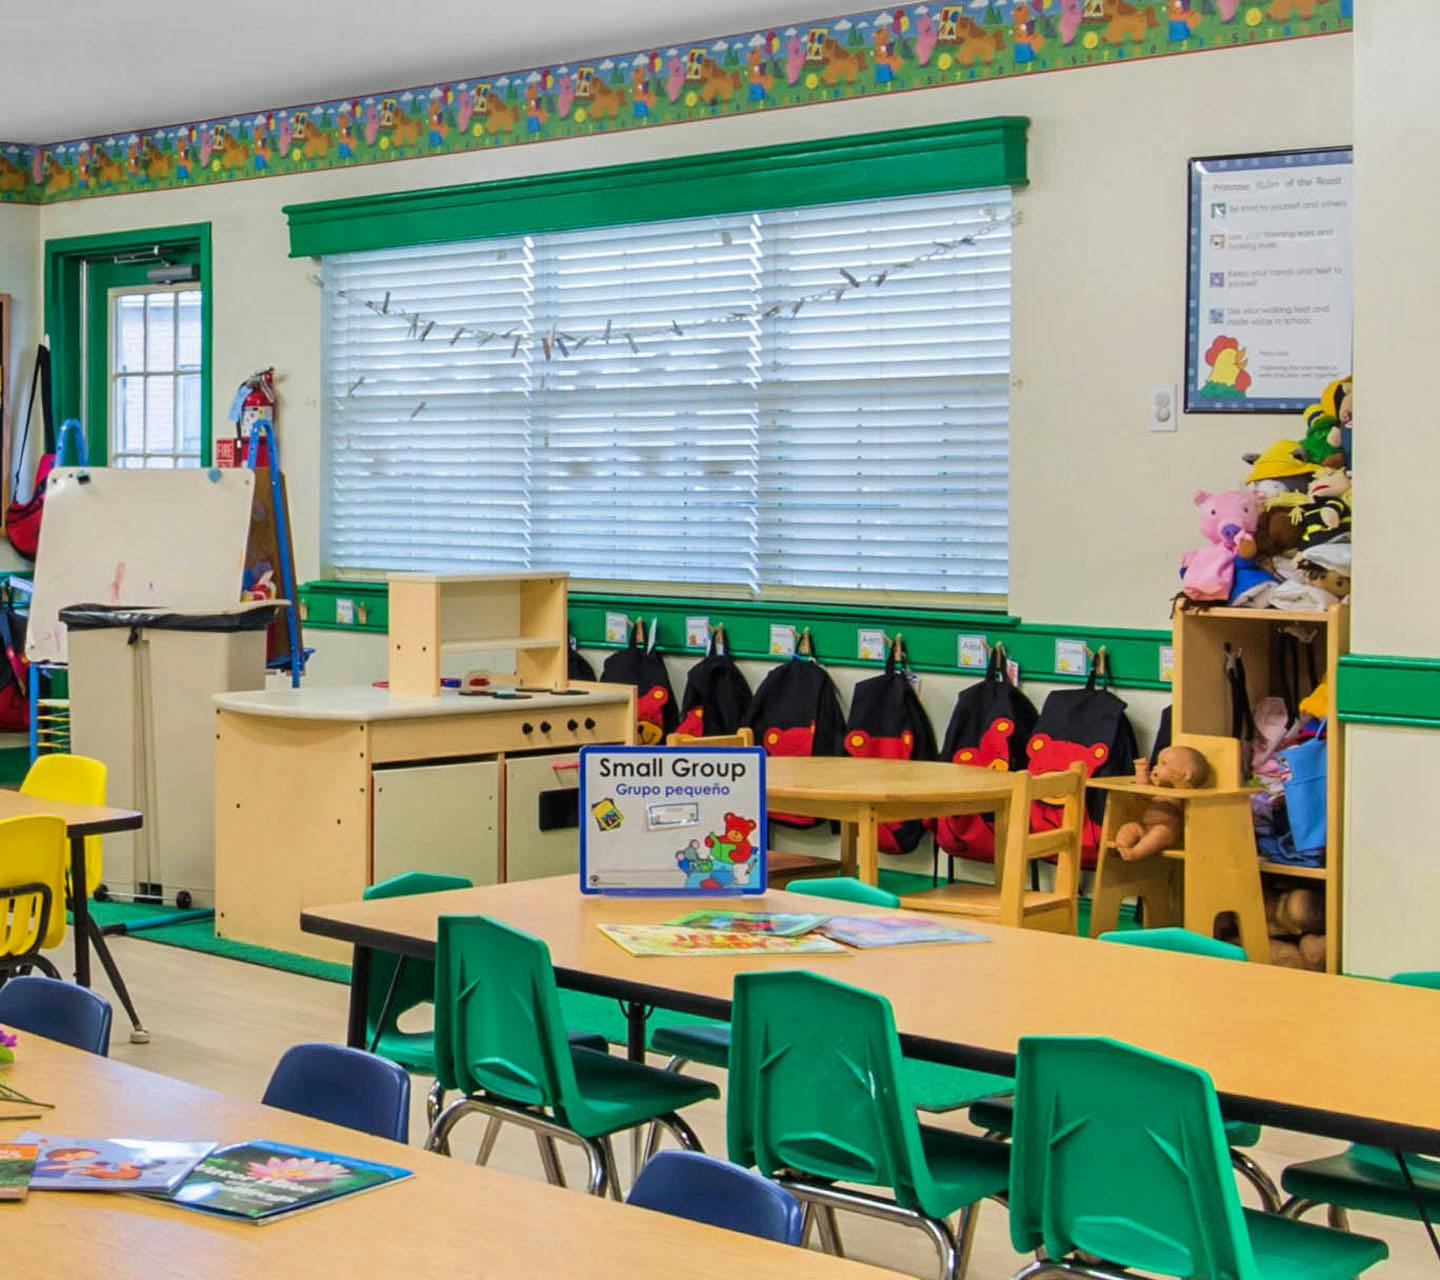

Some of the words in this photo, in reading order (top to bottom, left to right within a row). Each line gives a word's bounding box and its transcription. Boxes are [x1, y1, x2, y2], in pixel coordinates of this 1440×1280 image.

[599, 757, 663, 778] Small
[671, 757, 746, 782] Group
[615, 783, 661, 798] Grupo
[665, 783, 730, 799] pequeño
